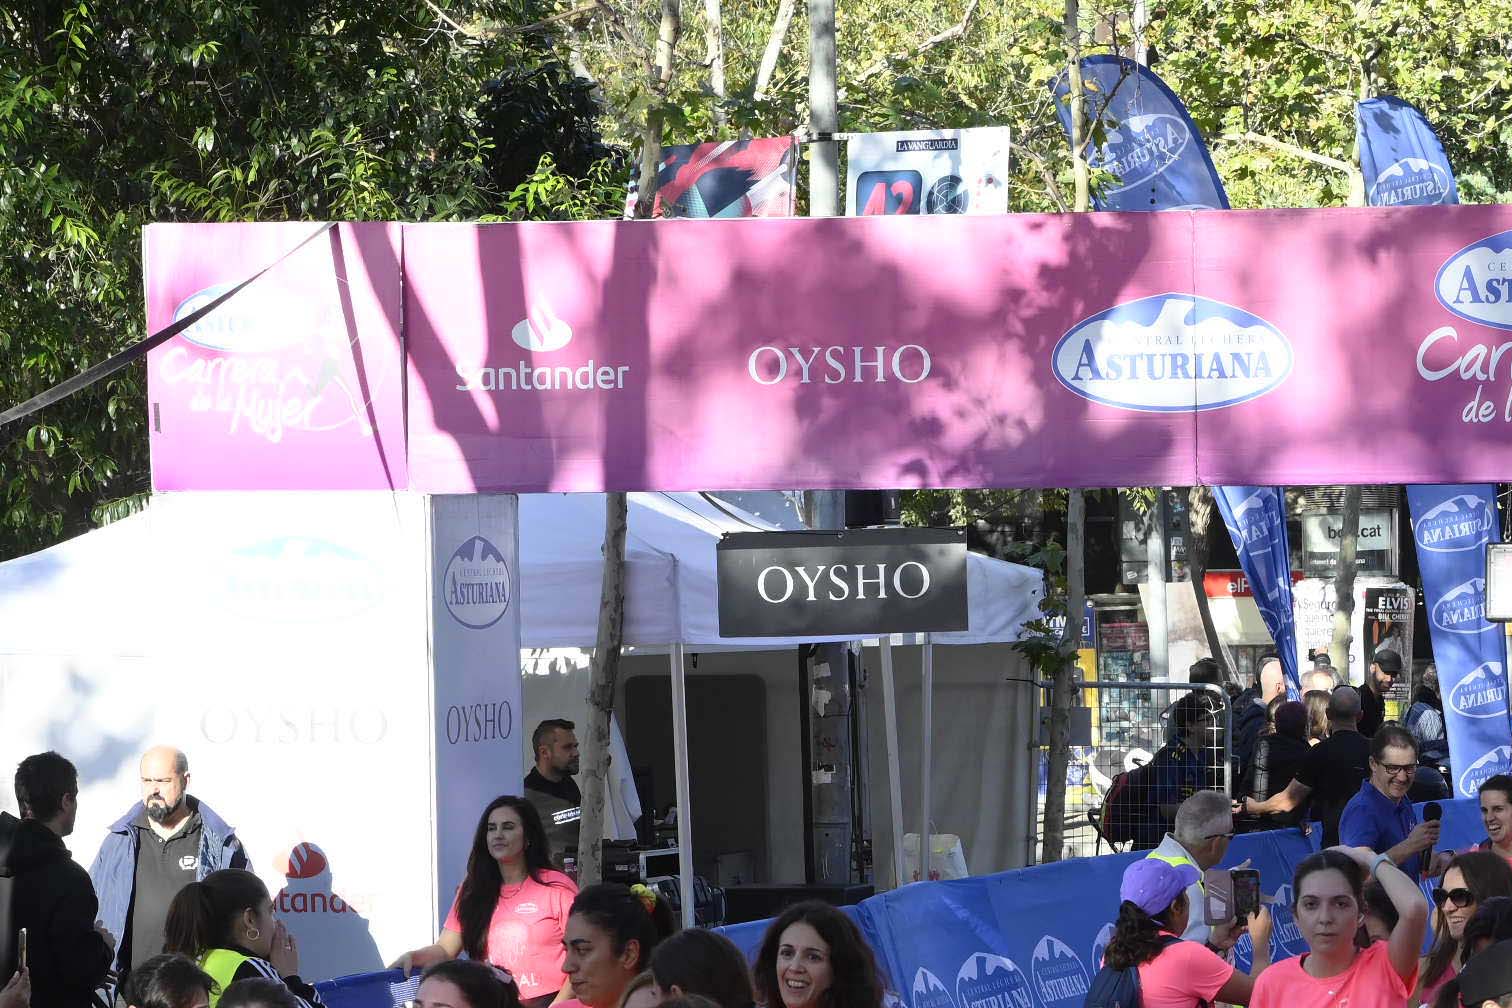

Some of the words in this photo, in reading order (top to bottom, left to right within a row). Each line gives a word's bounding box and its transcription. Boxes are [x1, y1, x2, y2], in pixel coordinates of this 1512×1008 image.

[456, 360, 629, 391] Santander
[747, 343, 932, 385] OYSHO
[1071, 339, 1273, 381] ASTURIANA
[1462, 392, 1496, 424] de
[450, 571, 506, 606] ASTURIANA
[757, 561, 931, 603] OYSHO
[446, 700, 512, 745] OYSHO
[1041, 975, 1088, 1004] ASTURIANA
